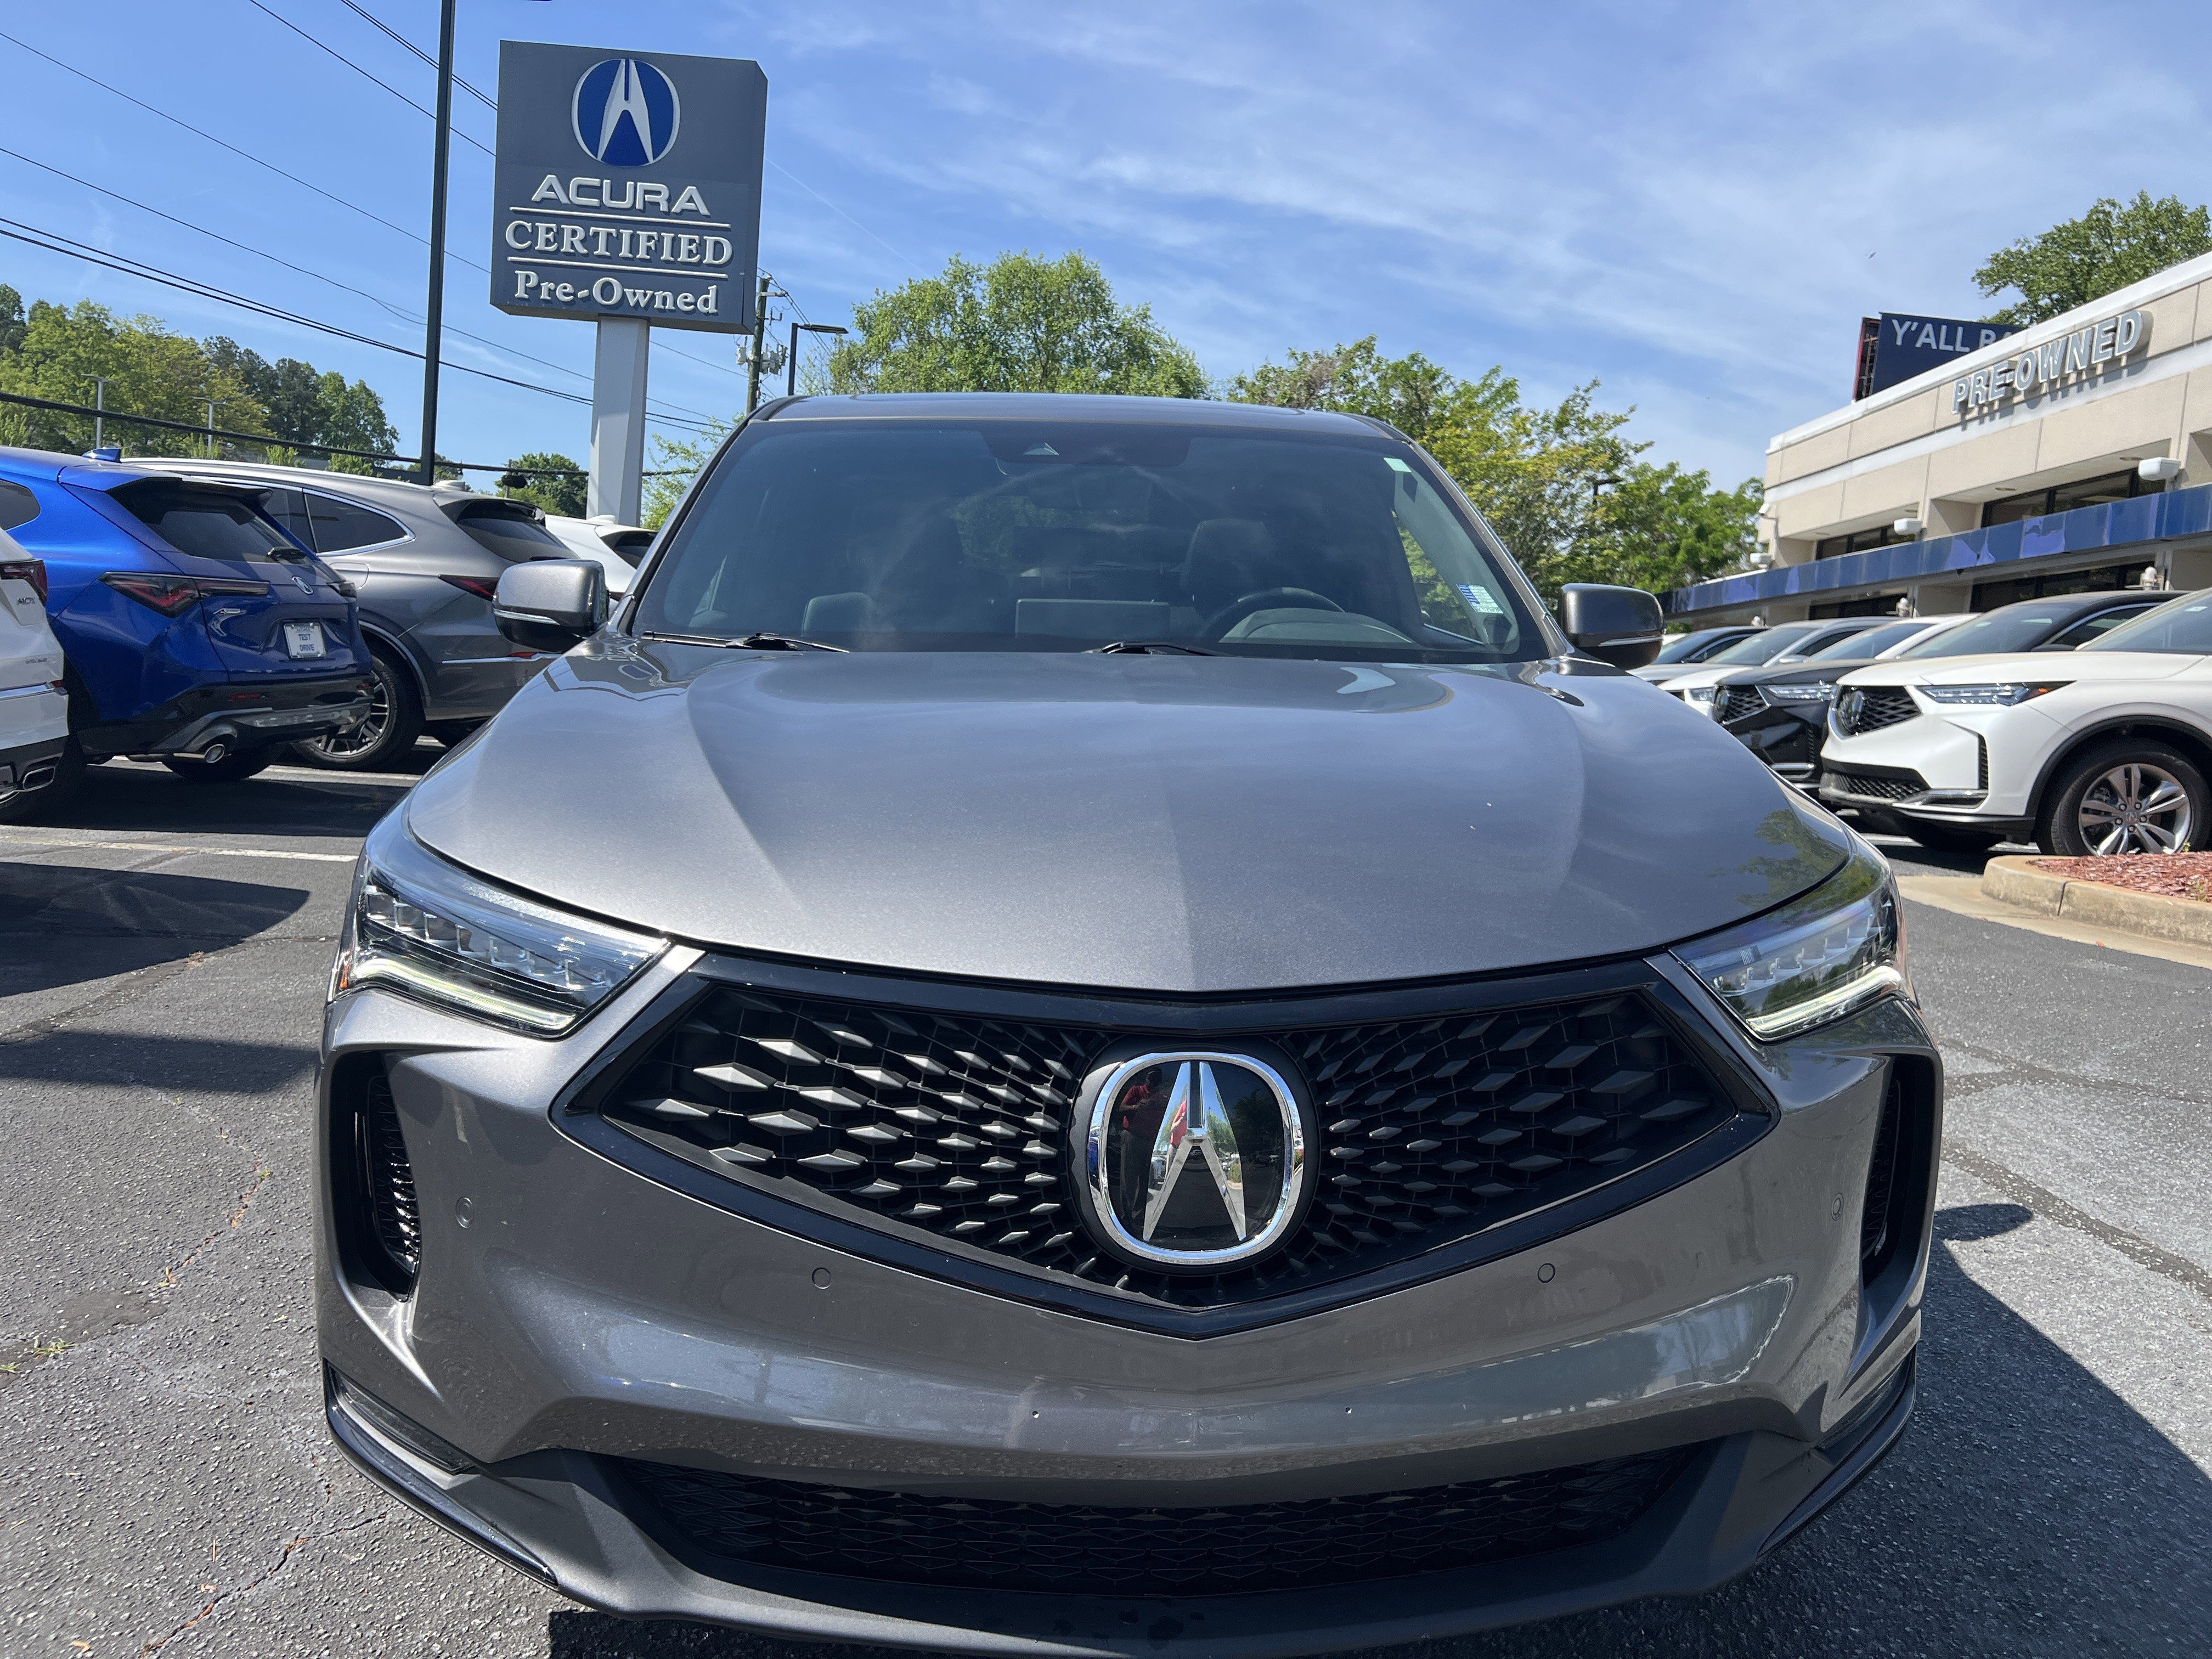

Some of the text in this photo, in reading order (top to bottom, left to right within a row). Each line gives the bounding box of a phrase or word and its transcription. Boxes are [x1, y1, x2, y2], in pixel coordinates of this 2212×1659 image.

[531, 174, 711, 216] ACURA
[505, 220, 733, 266] CERTIFIED
[514, 270, 719, 314] Pre-Owned
[1891, 319, 1971, 353] Y'ALL
[1951, 309, 2146, 415] PRE-OWNED
